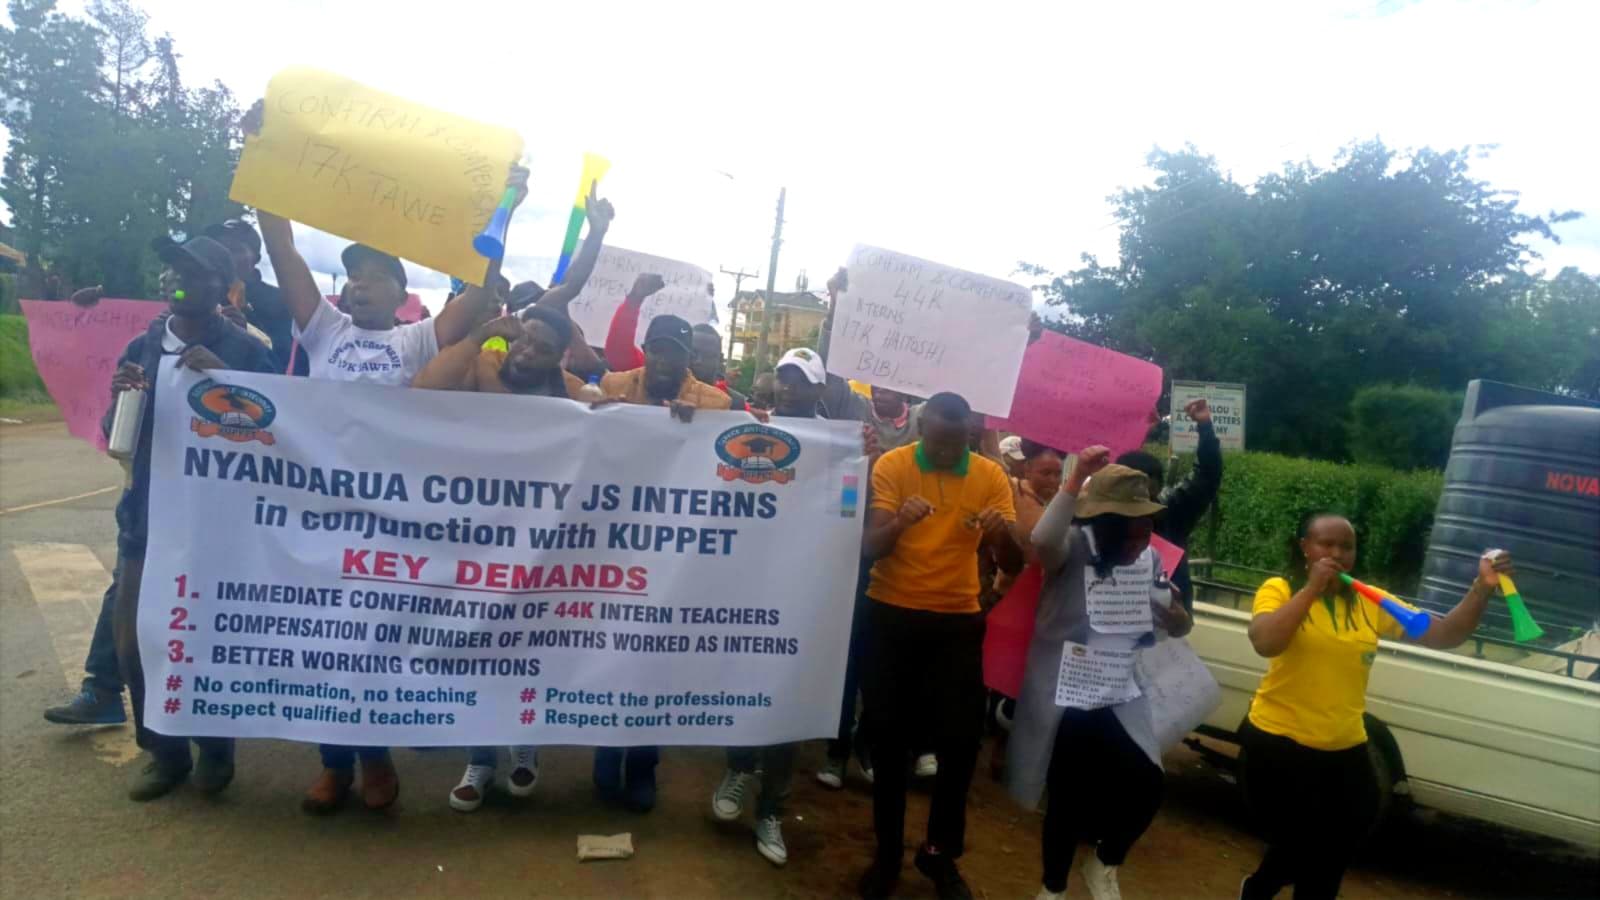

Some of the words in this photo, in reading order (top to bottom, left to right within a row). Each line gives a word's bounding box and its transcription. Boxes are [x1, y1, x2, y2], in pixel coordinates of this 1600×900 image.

[296, 135, 361, 198] 17K
[368, 169, 447, 228] TAWE
[1212, 415, 1241, 425] PETERS
[184, 446, 408, 502] NYANDARUA
[422, 474, 572, 511] COUNTY
[581, 484, 620, 512] JS
[631, 485, 777, 519] INTERNS
[1545, 471, 1600, 496] NOVA
[255, 496, 287, 527] in
[301, 510, 515, 548] conjunction
[529, 522, 596, 551] with
[608, 523, 738, 555] KUPPET
[341, 548, 429, 580] KEY
[456, 560, 648, 591] DEMANDS
[174, 574, 200, 600] 1.
[217, 581, 343, 608] IMMEDIATE
[350, 590, 516, 621] CONFIRMATION
[523, 602, 549, 621] OF
[554, 601, 594, 620] 44K
[601, 603, 673, 624] INTERN
[680, 607, 780, 626] TEACHERS
[169, 607, 197, 632] 2.
[214, 613, 367, 642] COMPENSATION
[375, 623, 401, 644] ON
[407, 626, 492, 649] NUMBER
[499, 631, 523, 649] OF
[528, 630, 606, 650] MONTHS
[613, 633, 690, 652] WORKED
[695, 635, 719, 653] AS
[723, 636, 799, 655] INTERNS
[167, 640, 194, 664] 3.
[211, 645, 294, 669] BETTER
[302, 651, 403, 675] WORKING
[410, 658, 541, 677] CONDITIONS
[165, 675, 183, 692] #
[194, 676, 223, 693] No
[230, 680, 356, 704] confirmation,
[363, 688, 391, 703] no
[395, 687, 477, 706] teaching
[520, 687, 537, 703] #
[545, 687, 614, 706] Protect
[619, 690, 649, 707] the
[654, 692, 773, 709] professionals
[163, 697, 181, 715] #
[191, 699, 276, 720] Respect
[282, 703, 361, 726] qualified
[368, 708, 456, 726] teachers
[519, 709, 537, 725] #
[545, 709, 619, 729] Respect
[624, 711, 671, 727] court
[677, 711, 734, 727] orders
